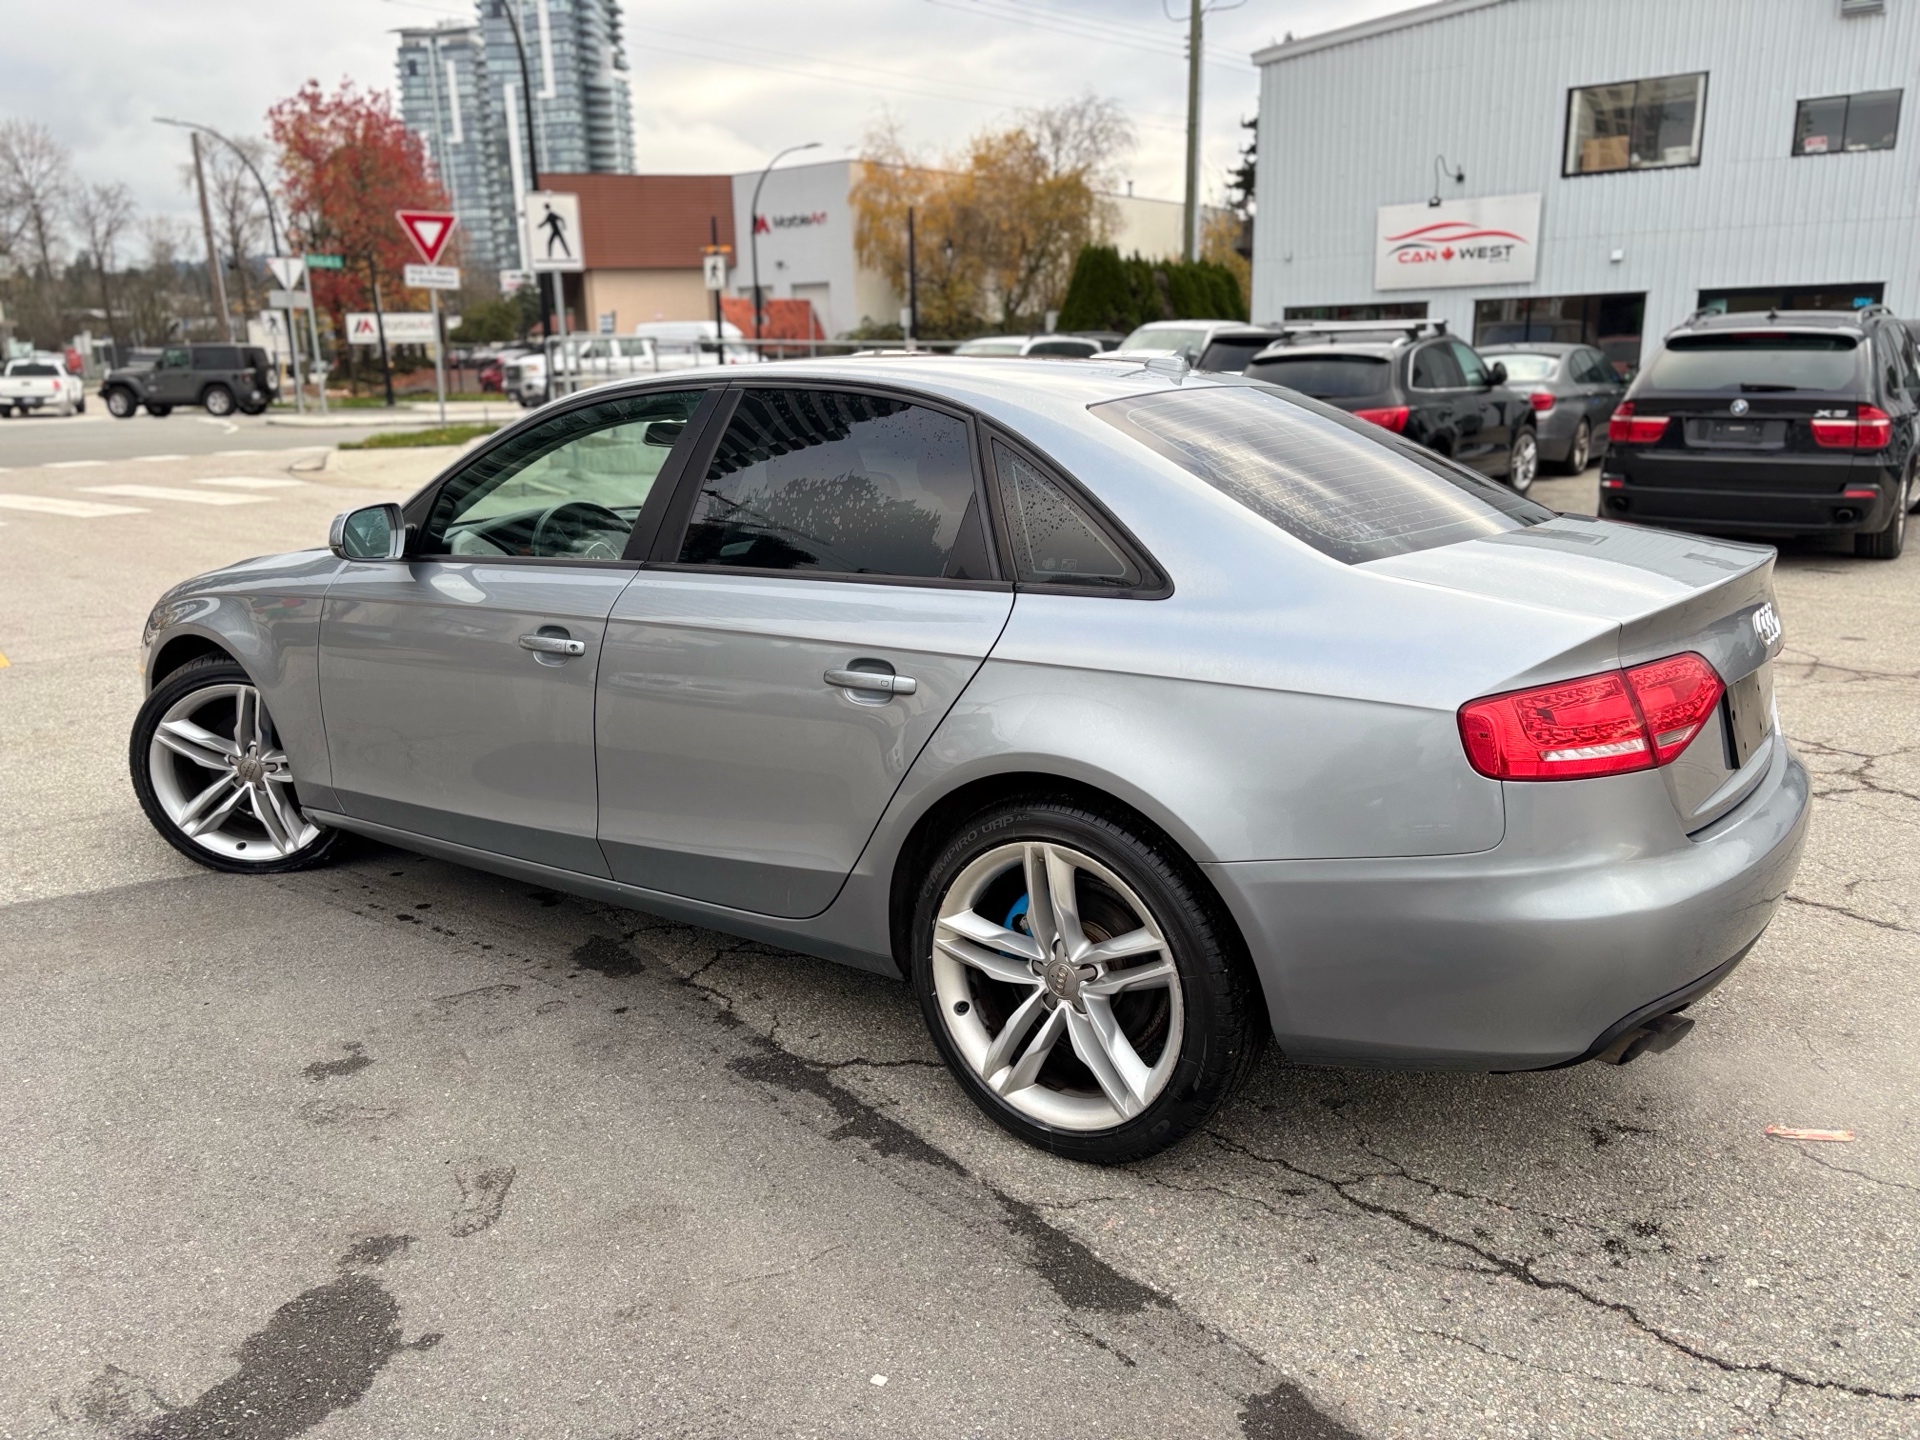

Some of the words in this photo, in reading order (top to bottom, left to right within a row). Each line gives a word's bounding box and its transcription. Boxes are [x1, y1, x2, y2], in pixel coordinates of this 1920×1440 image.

[1397, 250, 1437, 264] CAN
[1459, 244, 1515, 260] WEST
[923, 829, 978, 898] CHAMPIRO
